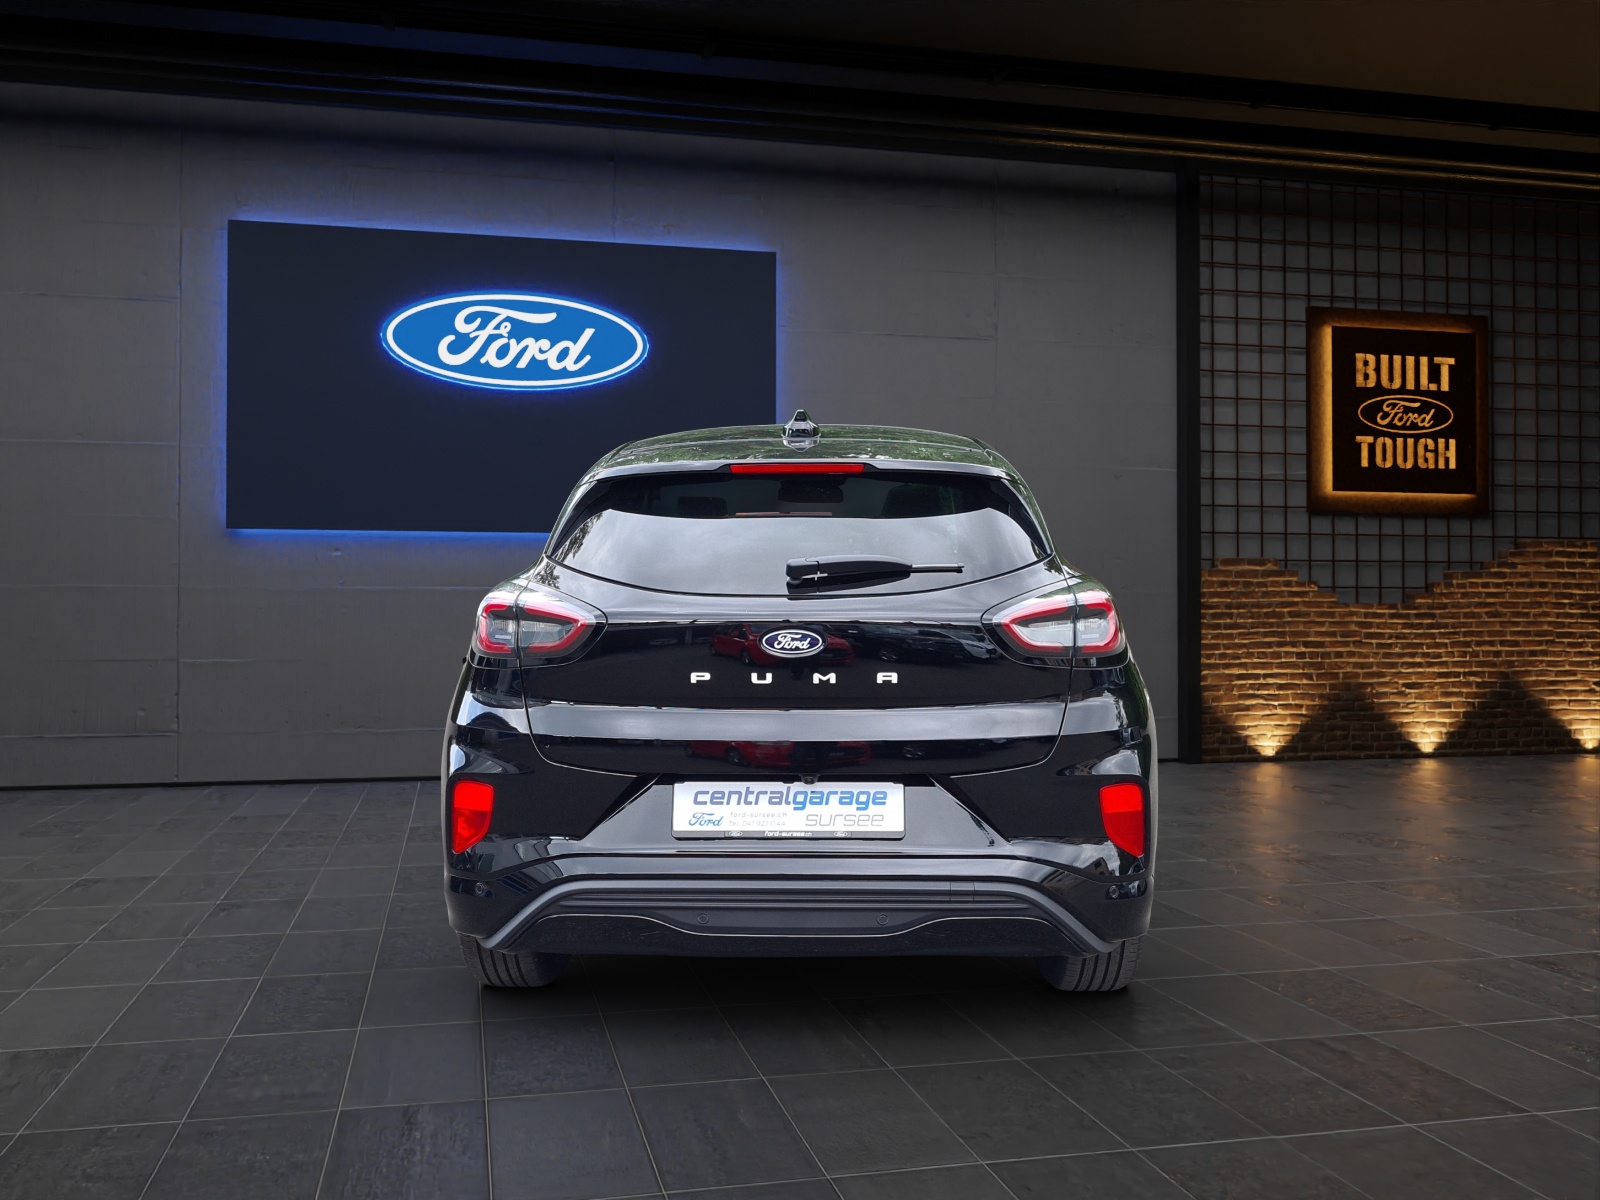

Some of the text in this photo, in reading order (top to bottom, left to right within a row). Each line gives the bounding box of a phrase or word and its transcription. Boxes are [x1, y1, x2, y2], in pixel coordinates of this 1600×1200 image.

[437, 305, 595, 371] Ford
[1355, 353, 1456, 391] BUILT
[1376, 399, 1436, 428] Ford
[1355, 435, 1457, 469] TOUGH
[773, 633, 811, 650] Ford
[690, 672, 898, 684] PUMA
[693, 786, 888, 811] centralgarage
[688, 811, 724, 827] Ford
[805, 813, 884, 827] sursee
